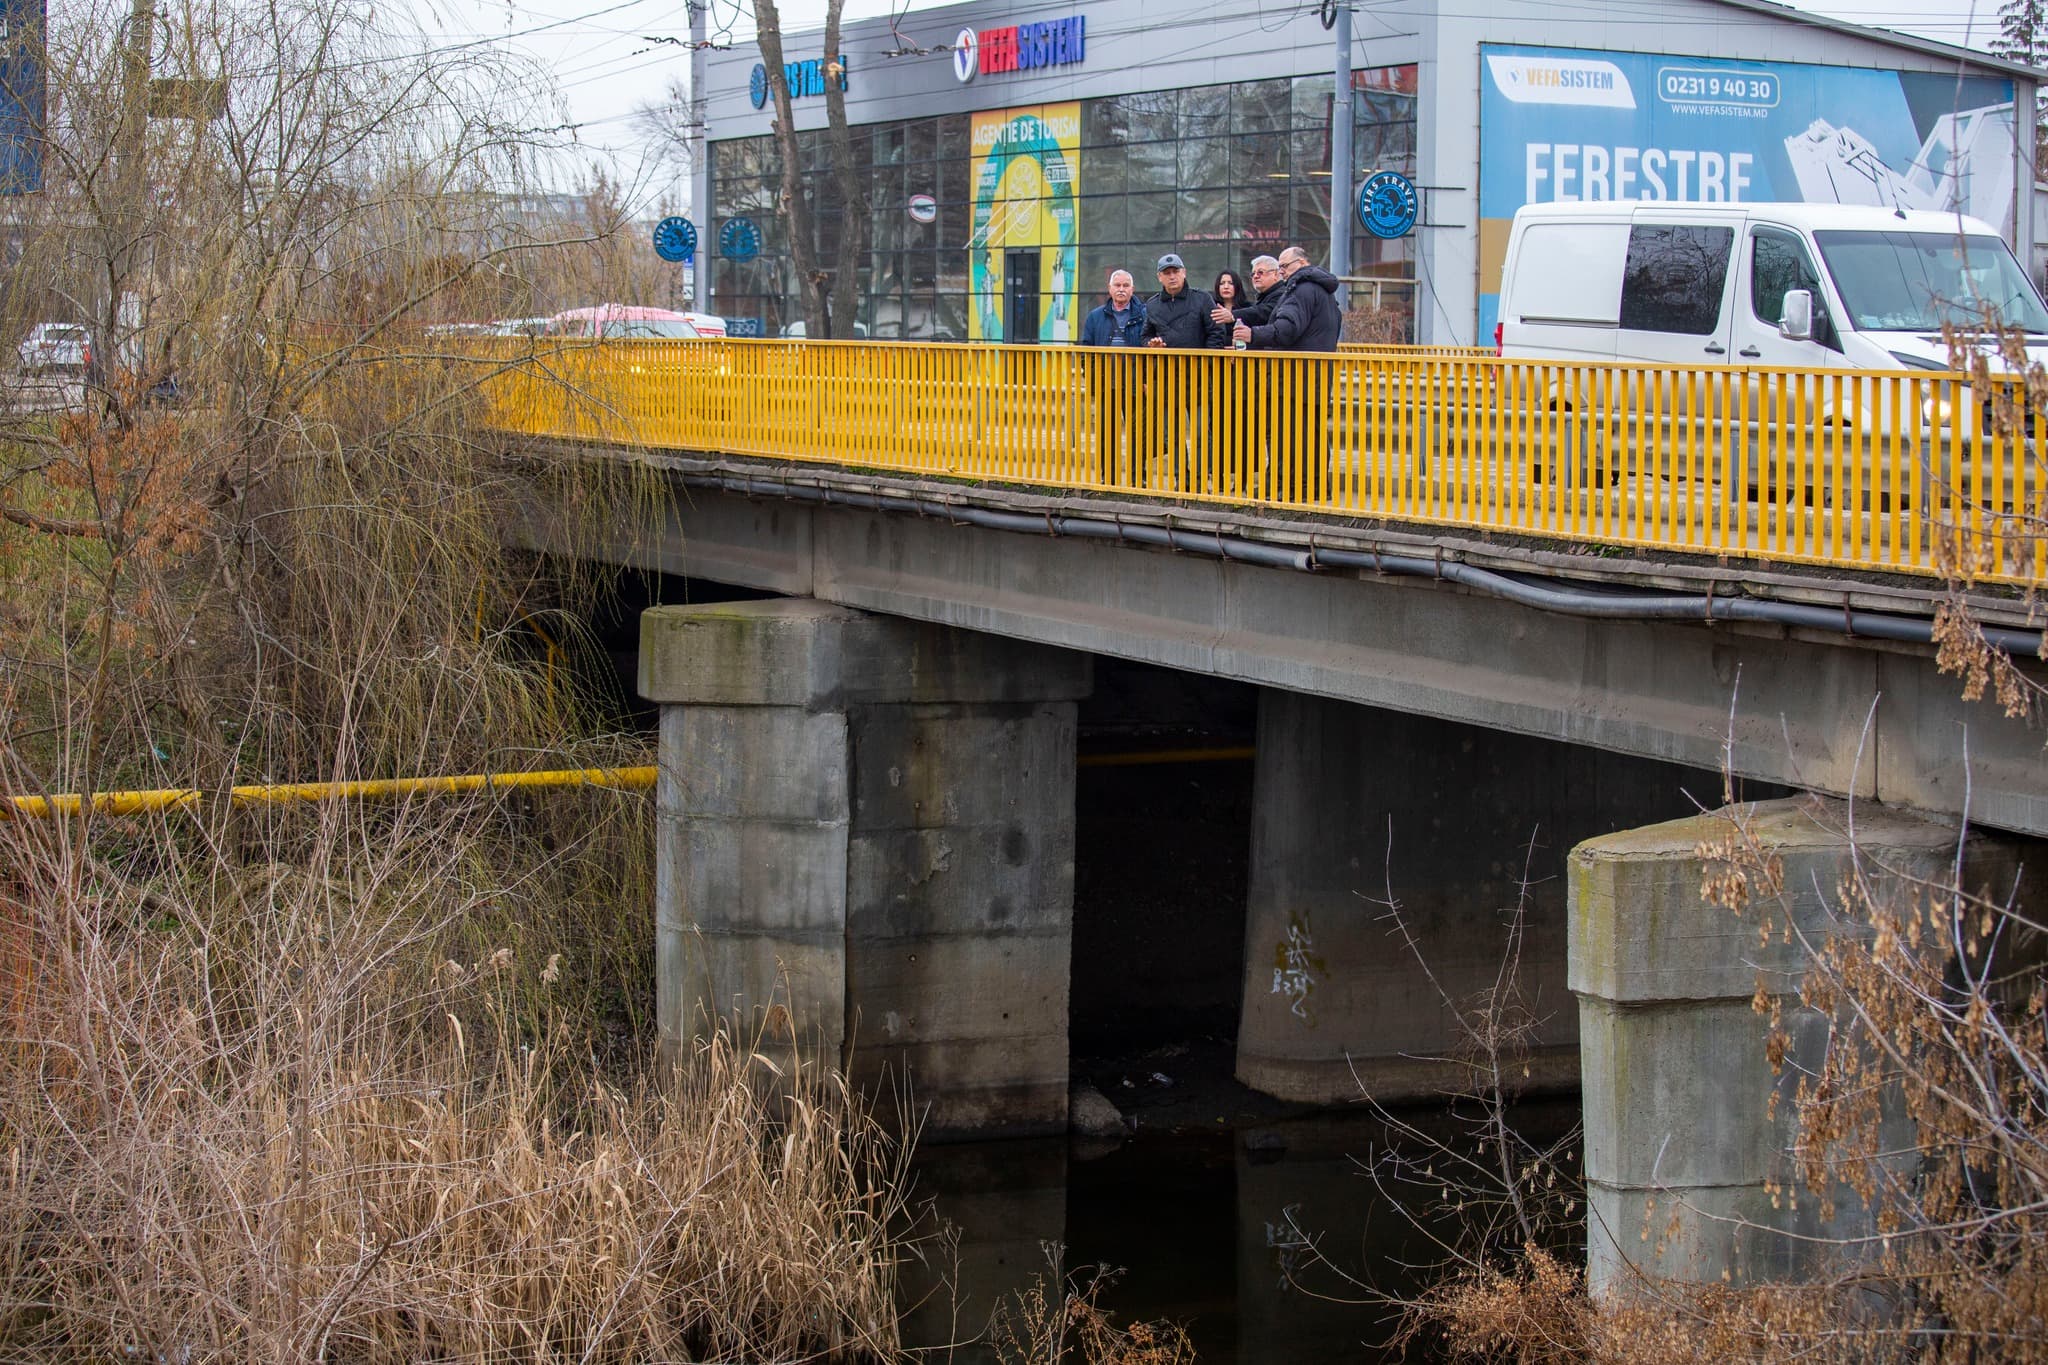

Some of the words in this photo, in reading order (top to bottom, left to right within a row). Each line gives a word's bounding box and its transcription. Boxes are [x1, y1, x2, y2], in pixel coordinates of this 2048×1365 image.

[1526, 68, 1613, 90] VEFASISTEM
[1666, 76, 1705, 95] 0231
[1709, 78, 1720, 95] 9
[1723, 79, 1746, 97] 40
[1749, 80, 1770, 98] 30
[1671, 103, 1768, 119] WWW.VEFASISTEM.MD
[1020, 119, 1036, 142] DE
[1036, 115, 1080, 141] TURISM
[1363, 182, 1379, 212] PIRS
[1383, 175, 1415, 214] TRAVEL
